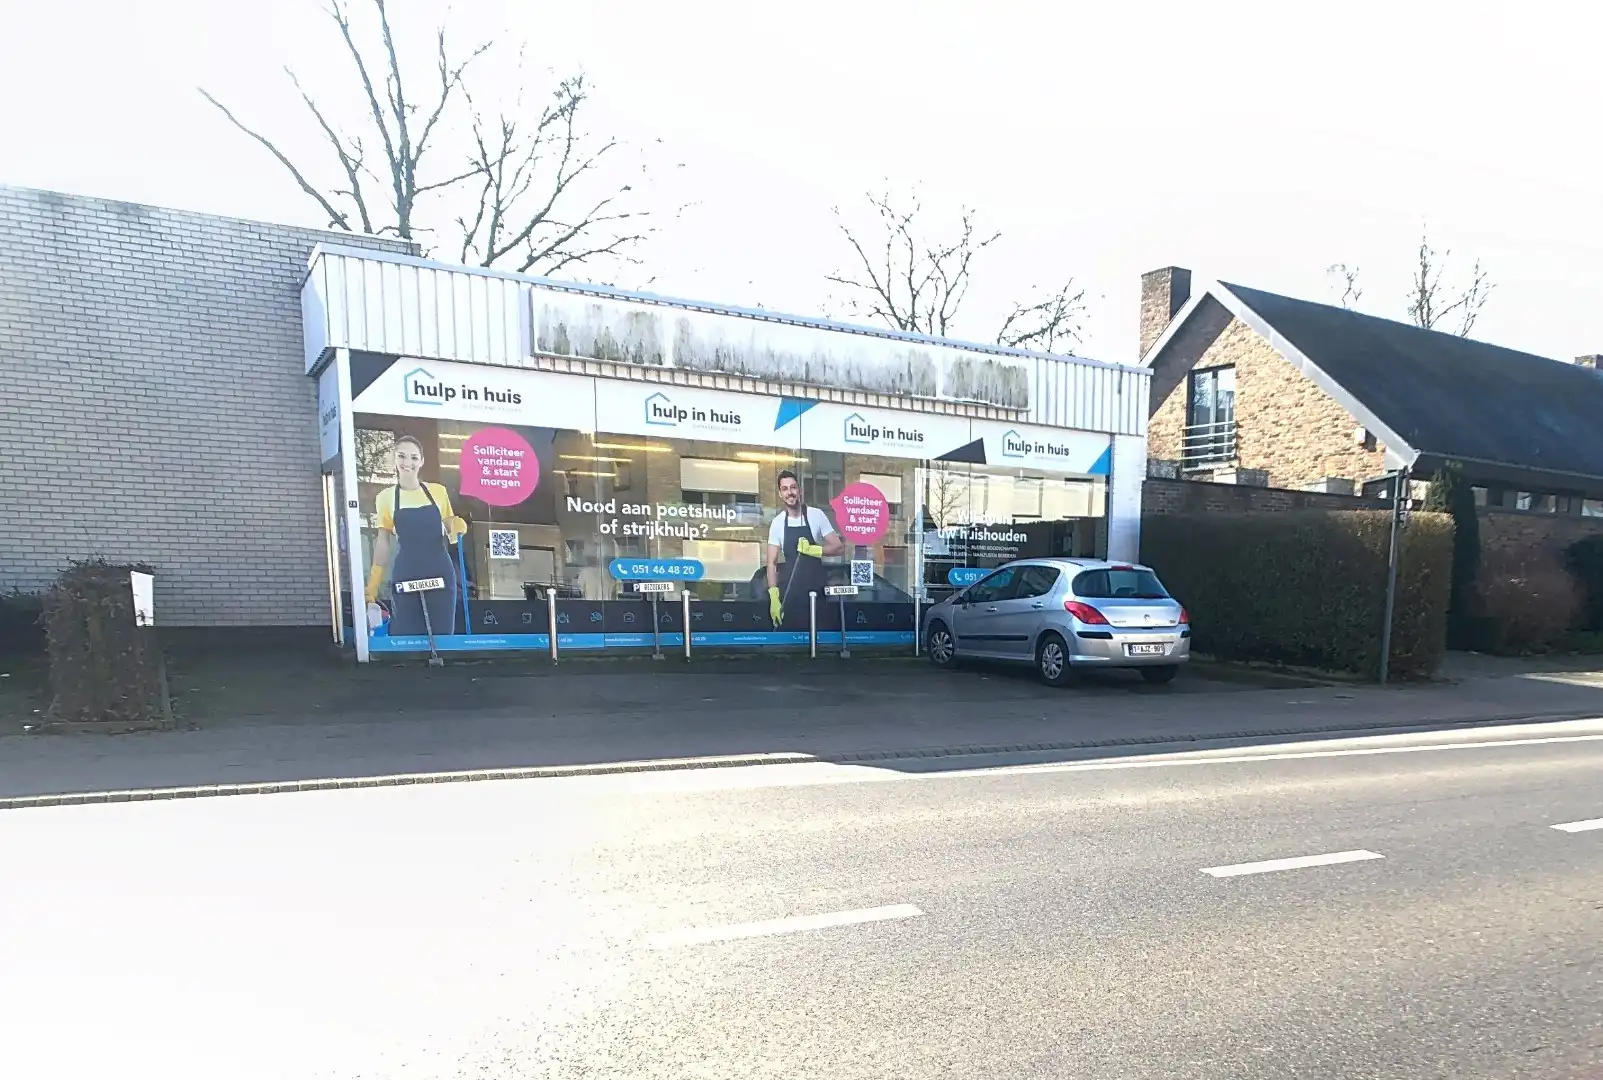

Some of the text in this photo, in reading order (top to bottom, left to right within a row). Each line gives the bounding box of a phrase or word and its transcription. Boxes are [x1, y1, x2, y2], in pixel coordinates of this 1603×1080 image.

[413, 380, 522, 404] hulp in huis
[653, 403, 742, 425] hulp in huis
[850, 423, 924, 442] hulp in huis
[473, 444, 525, 457] Solliciteer
[1007, 438, 1070, 456] hulp in huis
[477, 457, 522, 470] vandaag
[482, 466, 519, 477] & start
[480, 478, 521, 488] morgen
[843, 495, 883, 506] Solliciteer
[566, 496, 737, 523] Nood aan poetshulp
[846, 506, 880, 517] vandaag
[849, 514, 877, 524] & start
[600, 519, 709, 540] of strijkhulp?
[845, 525, 876, 534] morgen
[960, 527, 1027, 542] huishouden
[632, 564, 695, 575] 051 46 48 20
